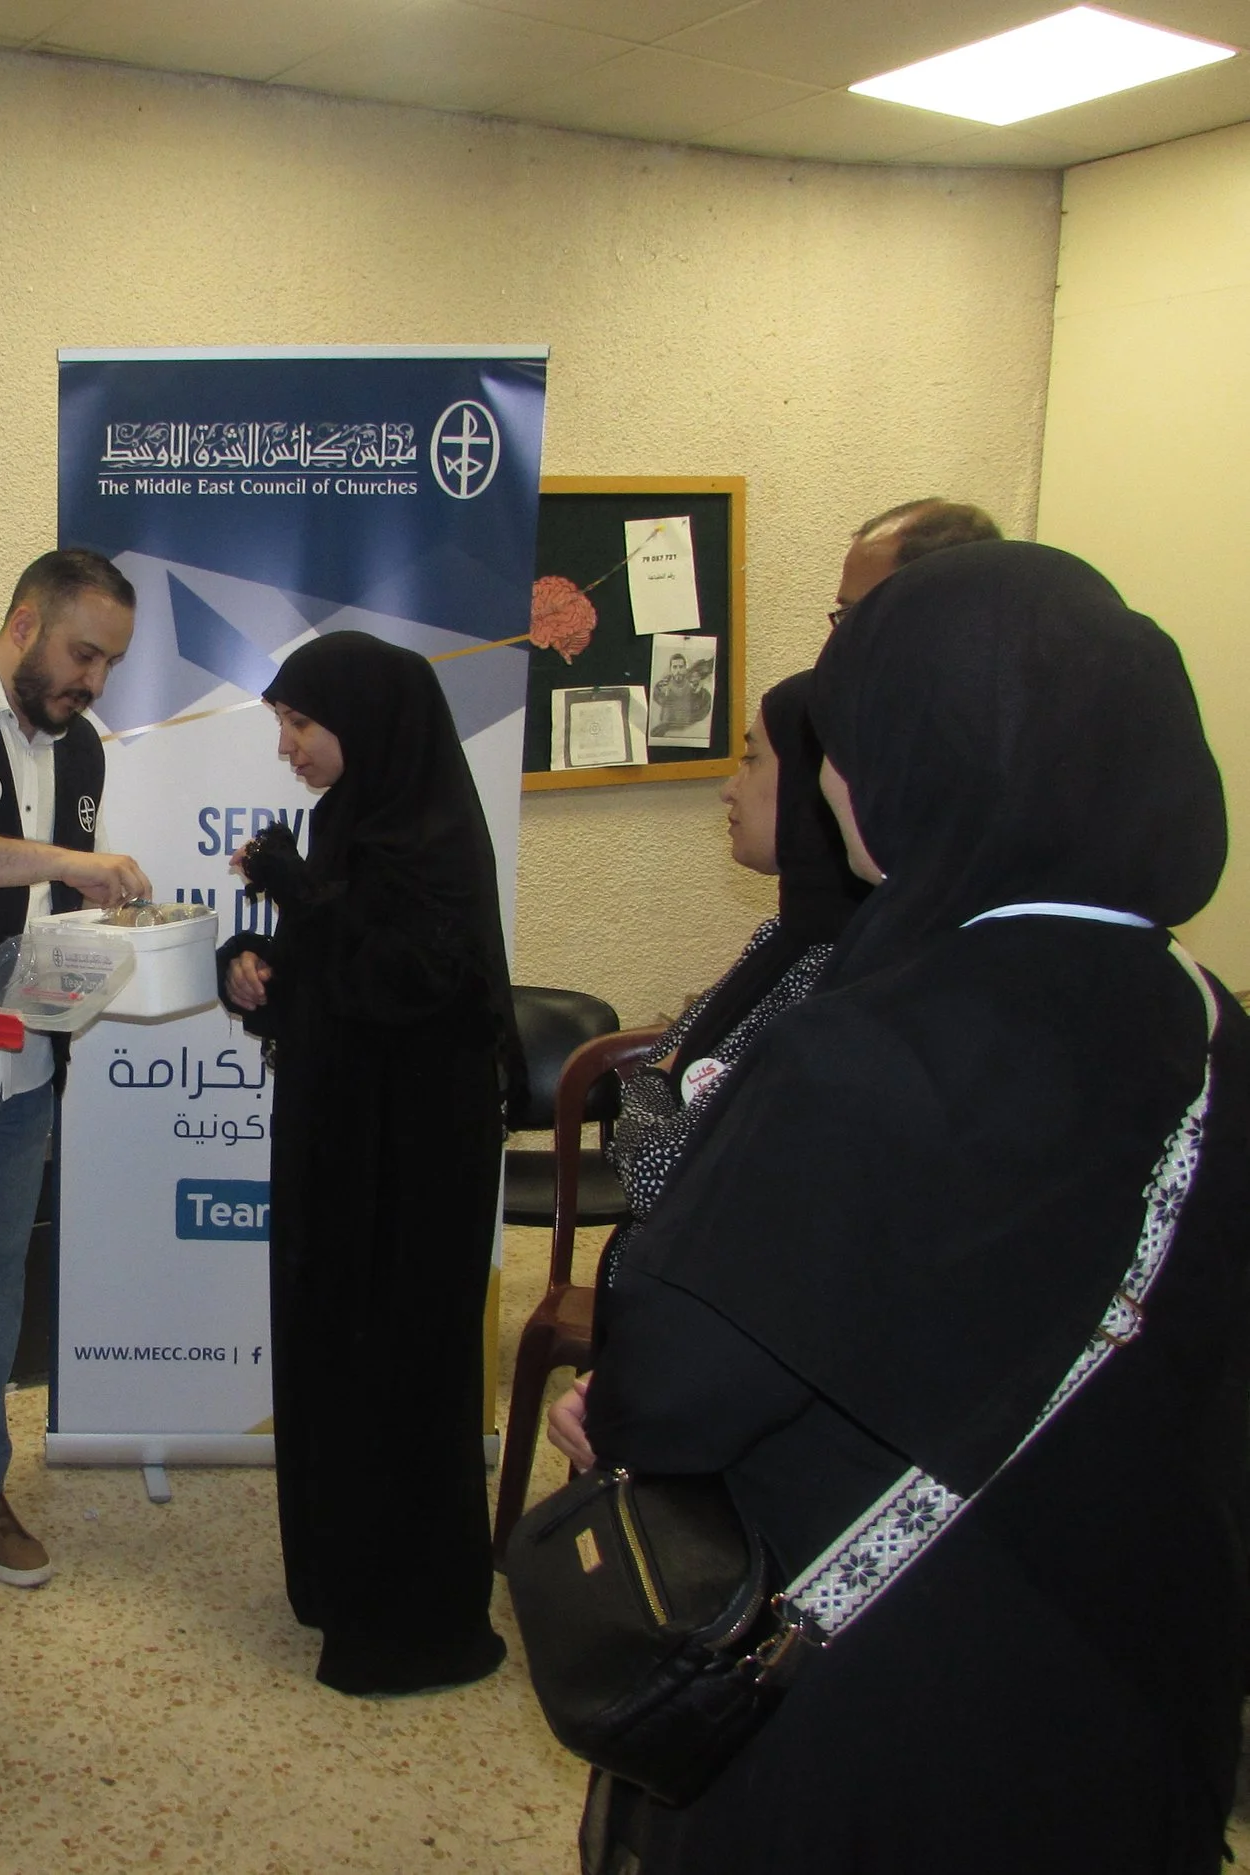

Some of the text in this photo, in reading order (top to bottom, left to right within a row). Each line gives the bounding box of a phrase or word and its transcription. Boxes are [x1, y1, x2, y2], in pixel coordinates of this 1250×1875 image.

[193, 422, 260, 468] الشرق
[262, 422, 347, 468] كنائس
[352, 422, 417, 468] مجلس
[98, 478, 418, 495] The Middle East Council of Churches
[109, 1046, 266, 1100] بكرامة
[686, 1062, 718, 1084] كلنا
[187, 1193, 270, 1228] Tear
[74, 1346, 226, 1361] WWW.MECC.ORG
